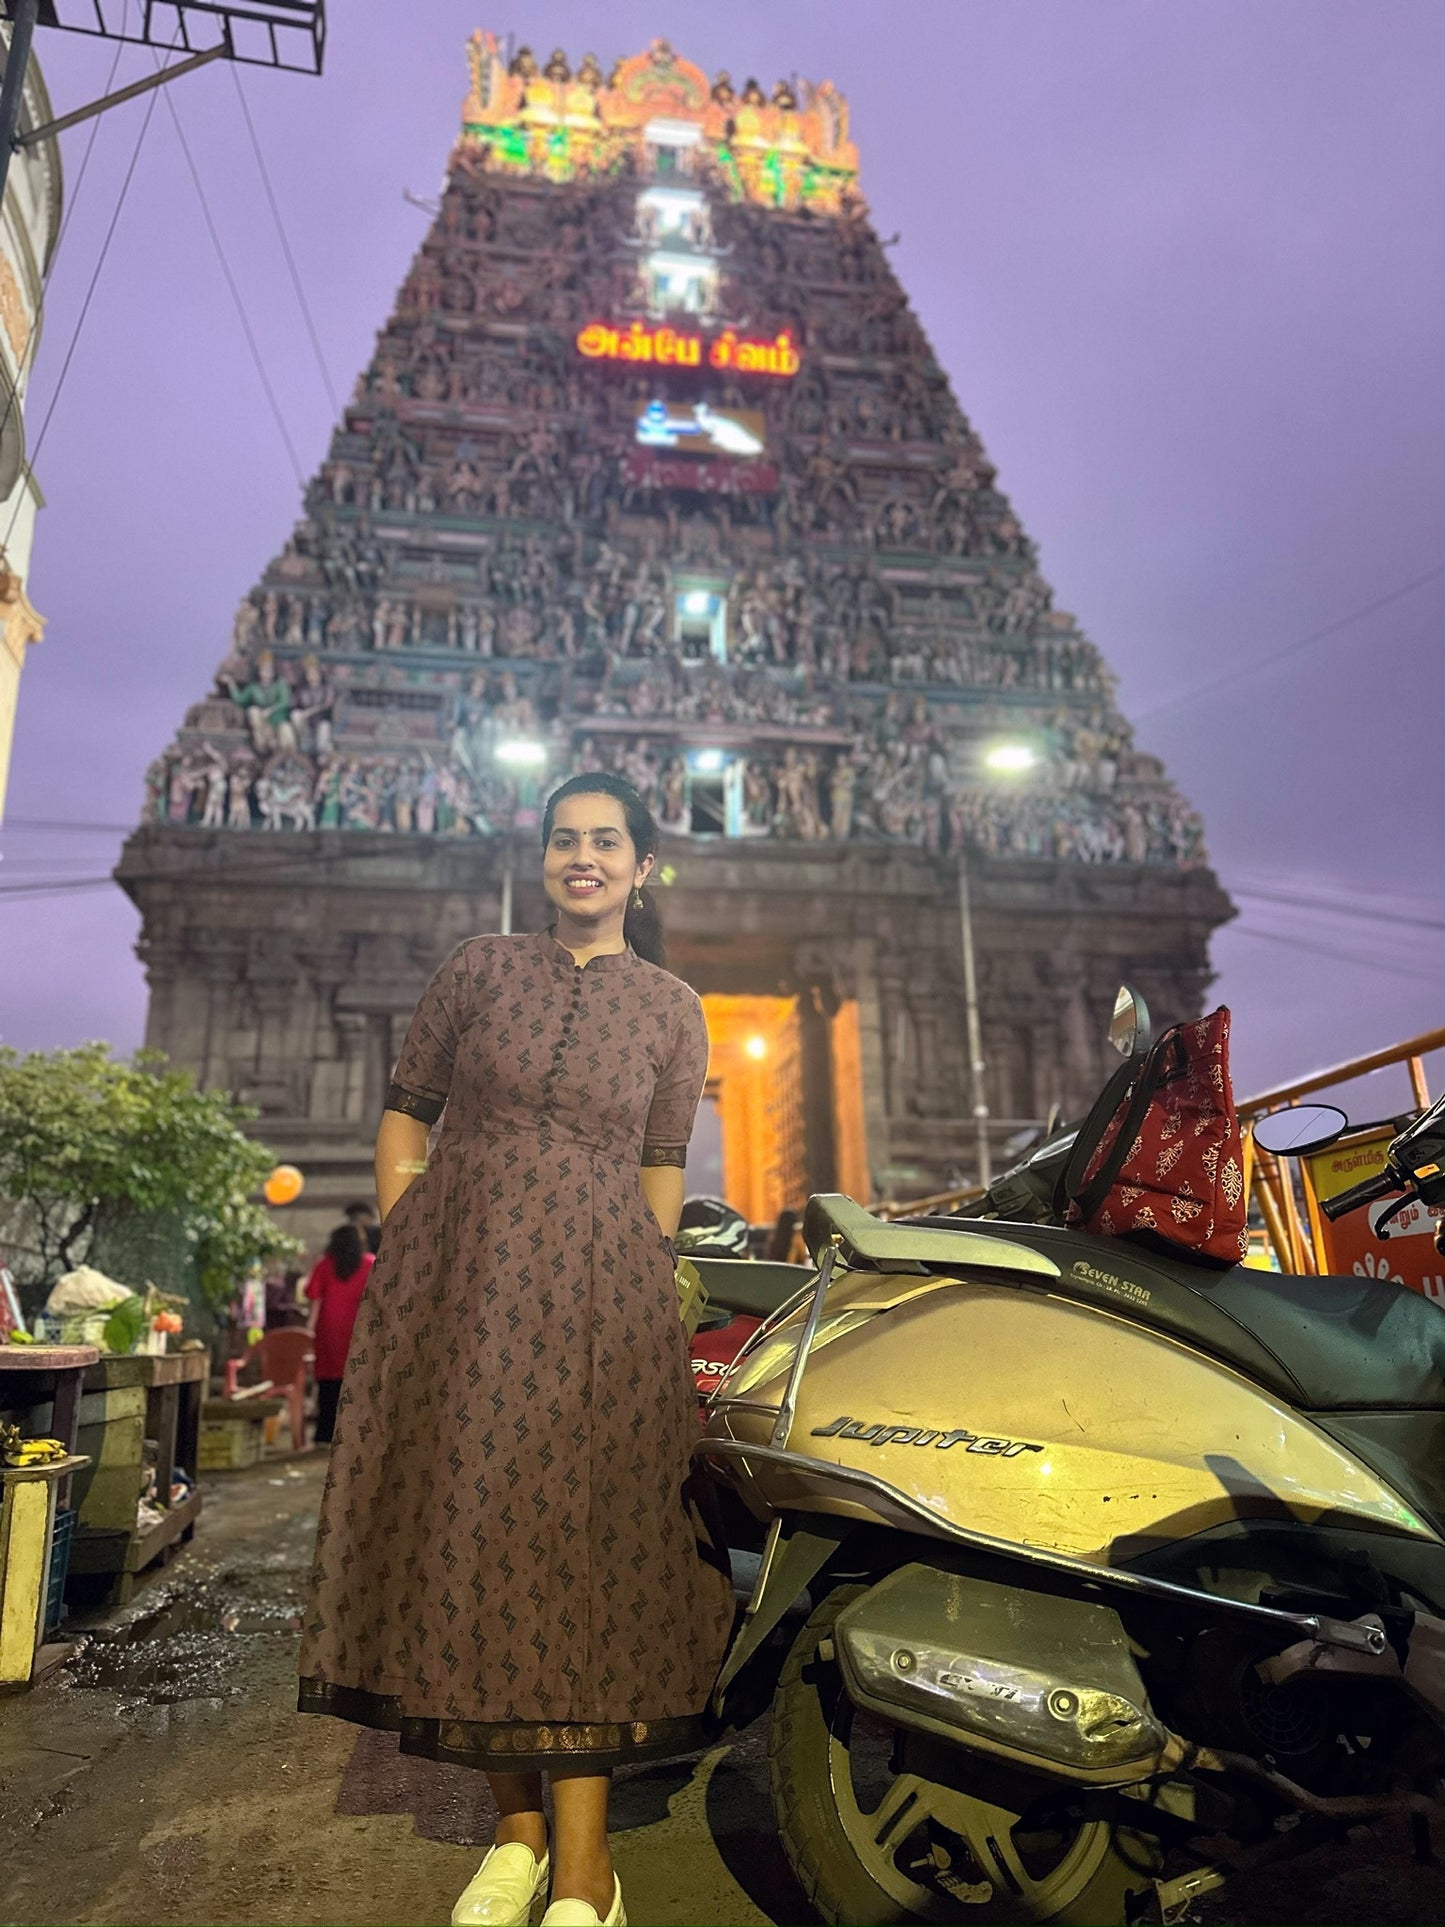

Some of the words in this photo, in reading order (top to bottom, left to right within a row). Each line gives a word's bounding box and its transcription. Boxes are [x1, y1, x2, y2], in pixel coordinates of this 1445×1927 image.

[577, 322, 701, 366] அன்பே
[709, 328, 799, 376] சிவம்
[1331, 1150, 1385, 1173] அருள்மிகு
[1080, 1266, 1120, 1287] SEVEN
[1121, 1281, 1152, 1301] STAR
[810, 1416, 1045, 1458] Jupiter
